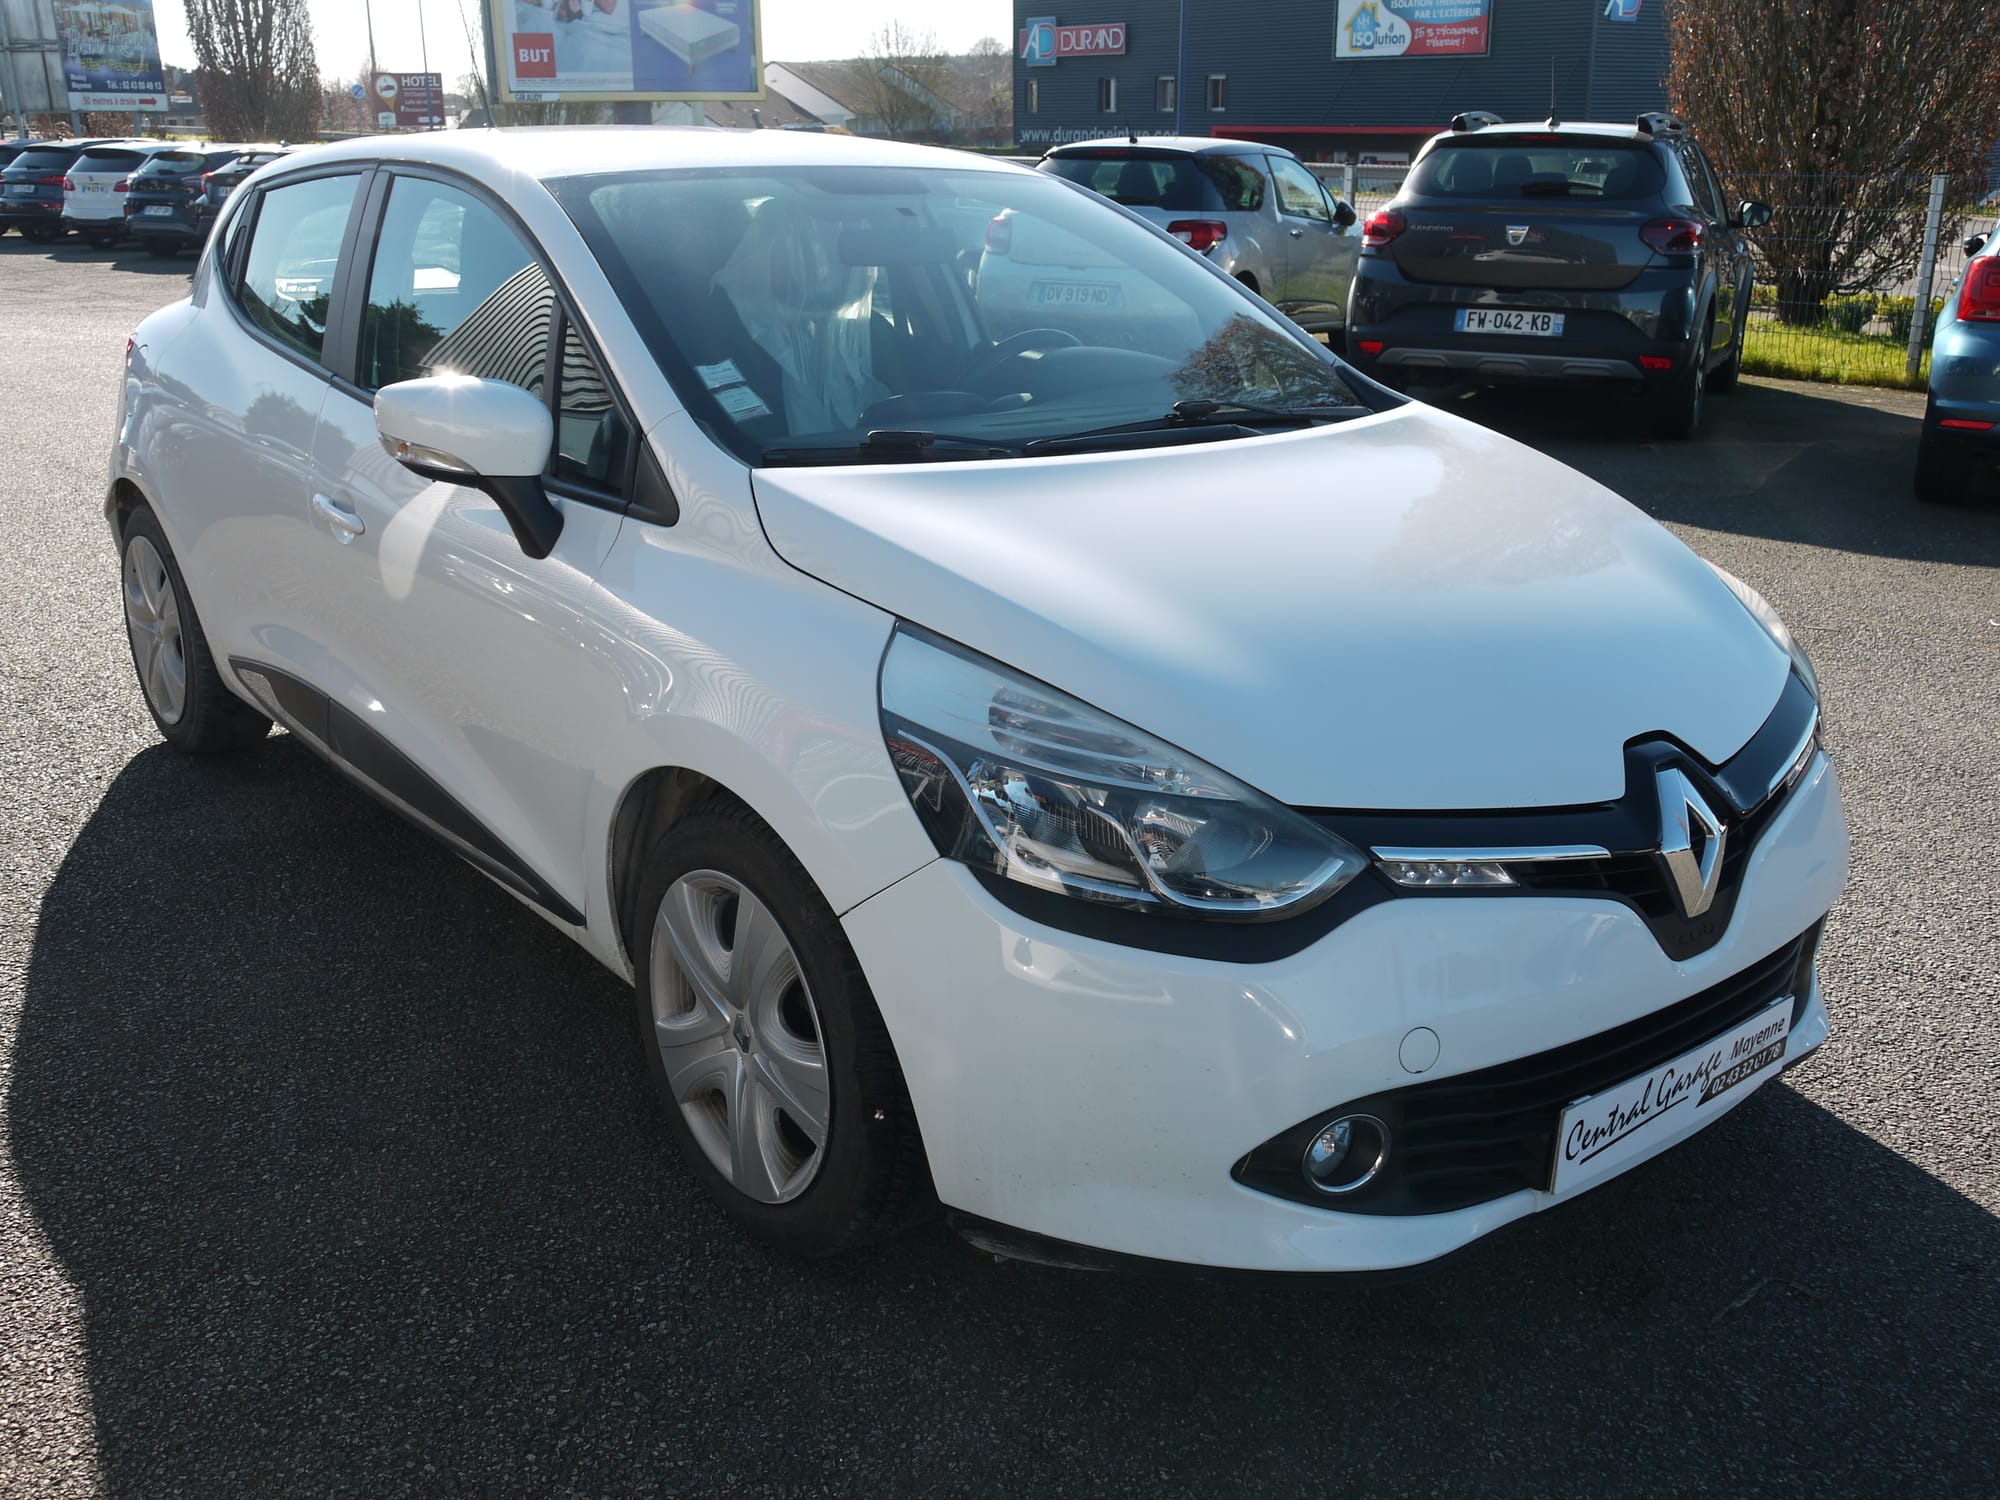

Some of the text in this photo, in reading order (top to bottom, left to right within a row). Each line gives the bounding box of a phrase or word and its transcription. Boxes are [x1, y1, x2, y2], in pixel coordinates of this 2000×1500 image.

[1391, 0, 1432, 9] ISOLATION
[1414, 9, 1430, 19] PAR
[1021, 23, 1124, 59] AD DURAND
[1352, 29, 1406, 47] ISOlution
[518, 48, 550, 63] BUT
[1467, 311, 1551, 331] FW-042-KB
[1565, 1017, 1785, 1161] Central Garage Mayenne
